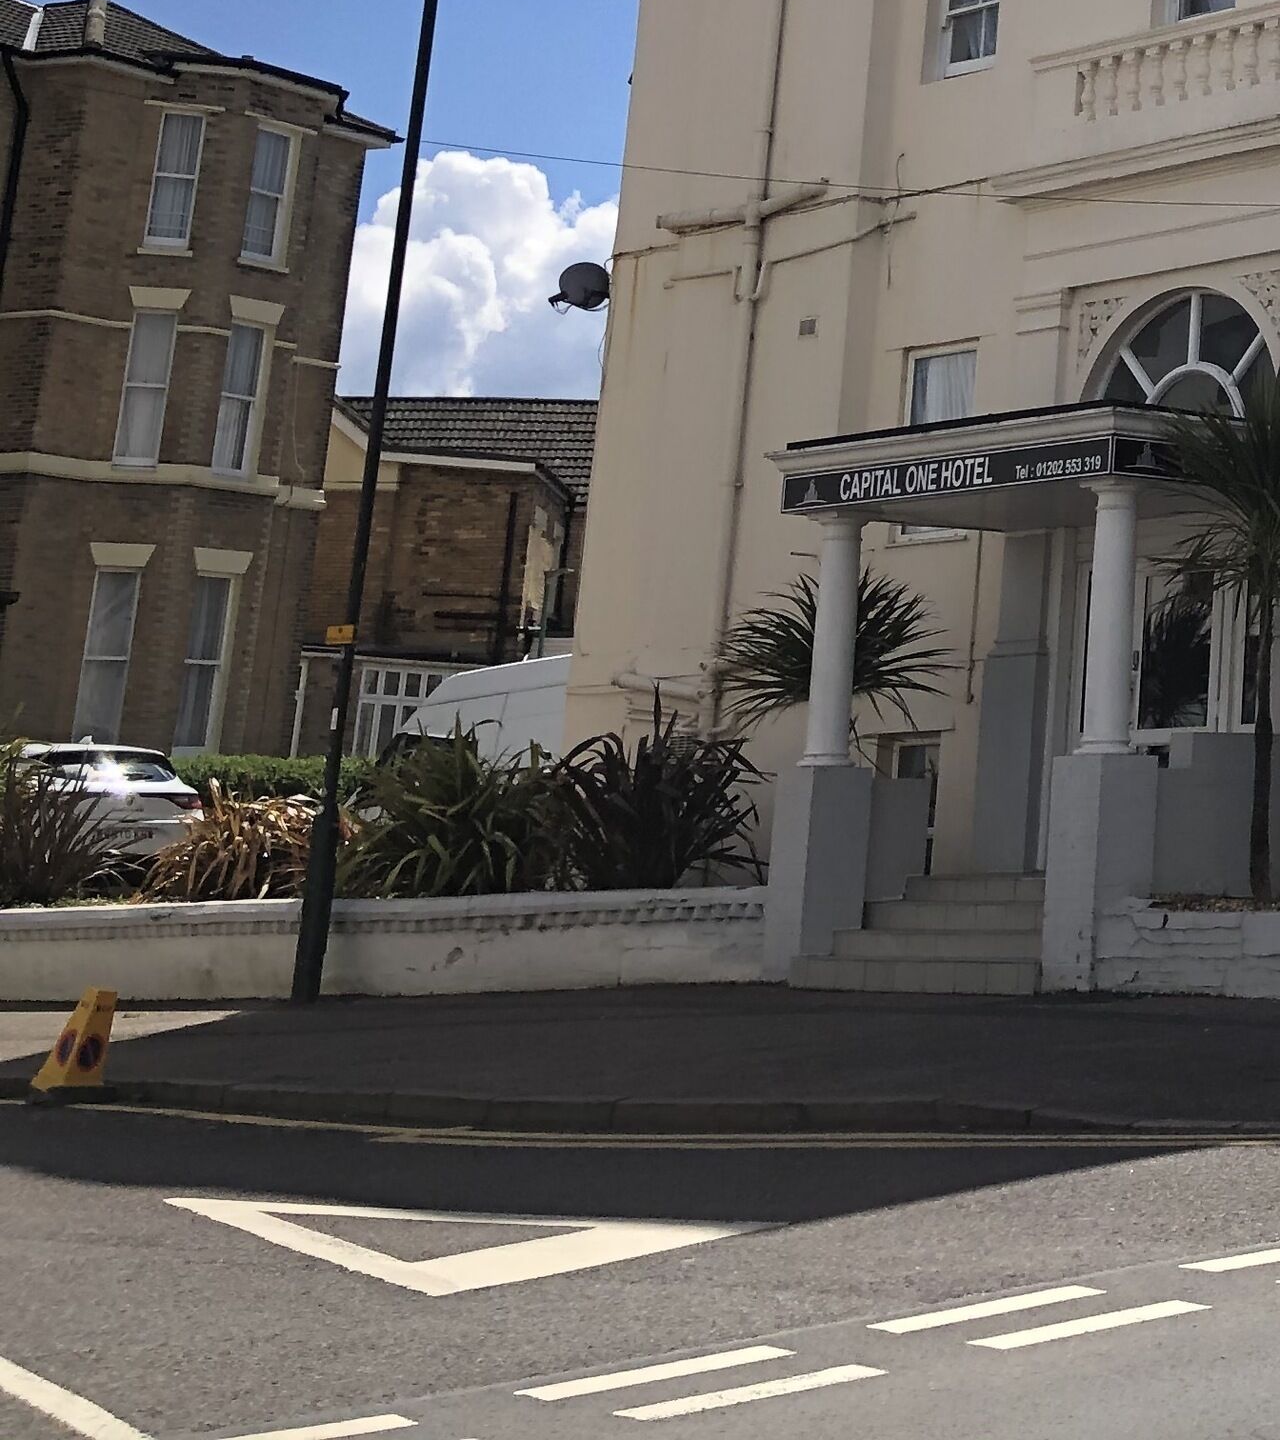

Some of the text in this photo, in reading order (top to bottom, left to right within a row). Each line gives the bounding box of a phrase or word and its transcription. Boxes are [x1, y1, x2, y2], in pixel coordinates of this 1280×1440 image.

[840, 457, 993, 500] CAPITAL ONE HOTEL
[1036, 460, 1063, 477] 01202
[1065, 457, 1082, 474] 553
[1084, 455, 1101, 471] 319
